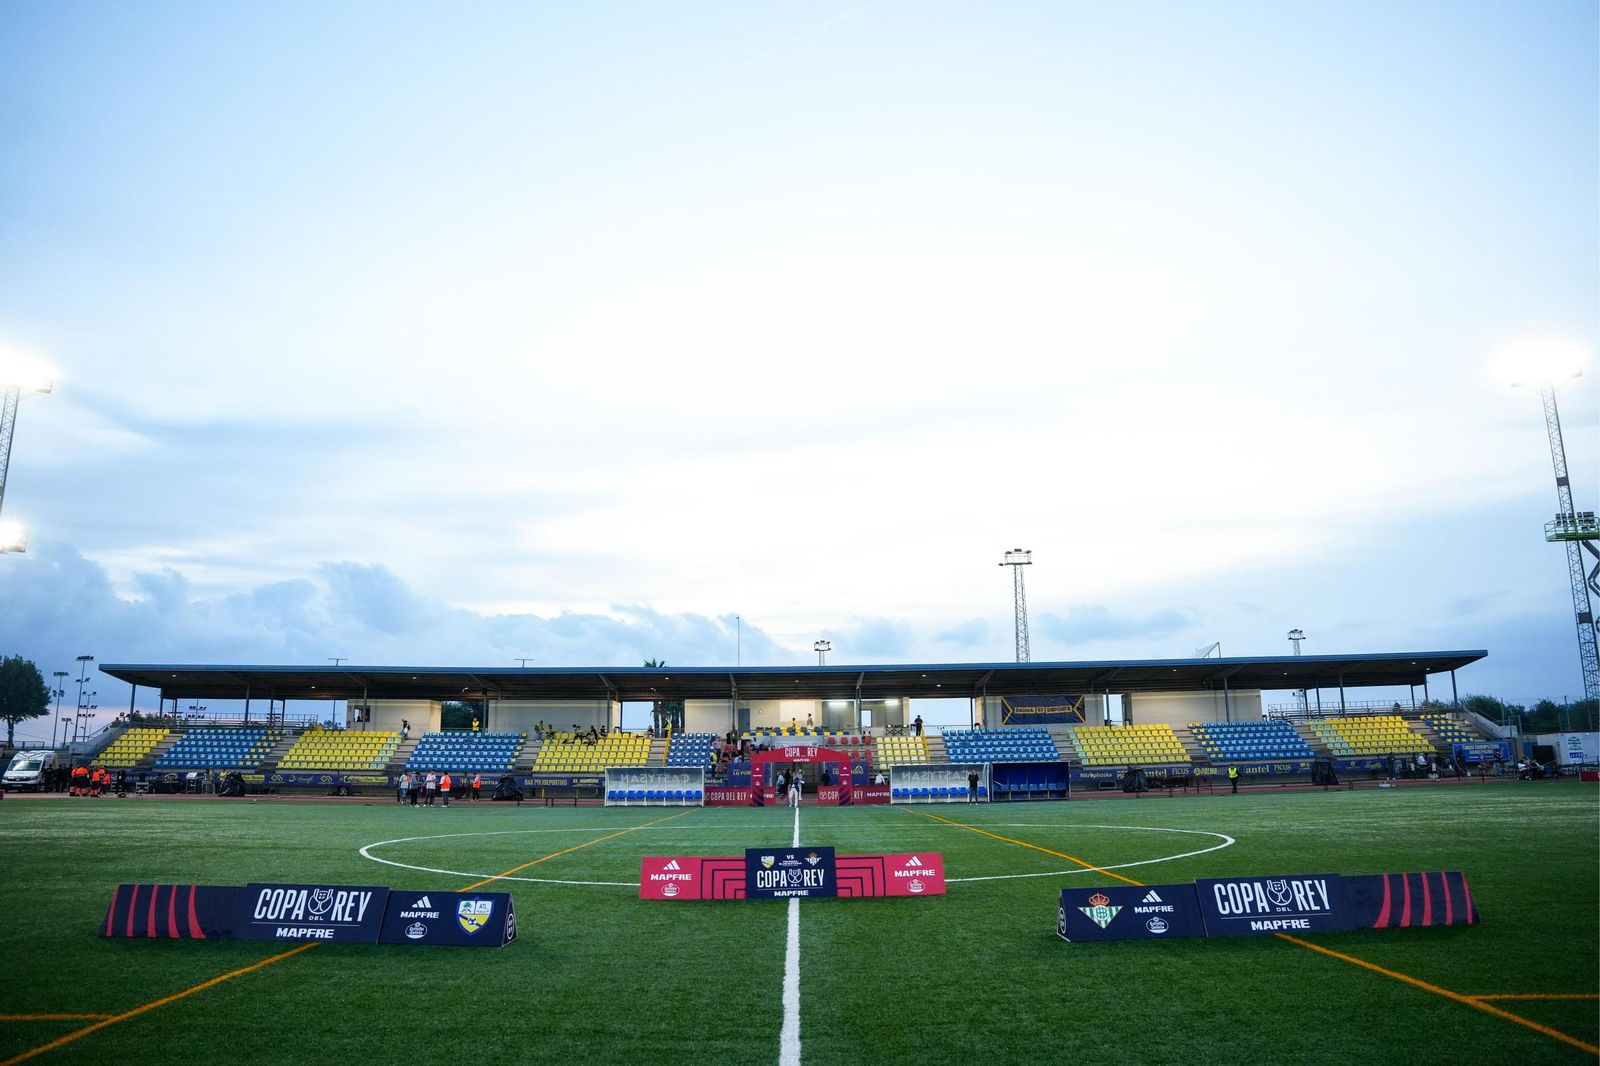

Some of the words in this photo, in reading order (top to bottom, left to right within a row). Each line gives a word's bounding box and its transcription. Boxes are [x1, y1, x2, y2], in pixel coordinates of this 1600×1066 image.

[784, 747, 800, 757] COPA
[807, 747, 818, 757] REY
[1245, 765, 1270, 774] antel
[711, 791, 725, 800] COPA
[726, 791, 736, 800] DEL
[737, 791, 747, 801] REY
[827, 791, 839, 800] COP
[853, 790, 864, 800] REY
[650, 873, 692, 881] MAPFRE
[757, 870, 788, 888] COPA
[803, 868, 825, 887] REY
[894, 869, 936, 877] MAPFRE
[1213, 882, 1270, 914] COPA
[1291, 879, 1330, 911] REY
[253, 888, 308, 920] COPA
[330, 890, 373, 922] REY
[1133, 905, 1174, 914] MAPFRE
[400, 911, 440, 919] MAPFRE
[1250, 918, 1311, 931] MAPFRE
[275, 927, 335, 939] MAPFRE
